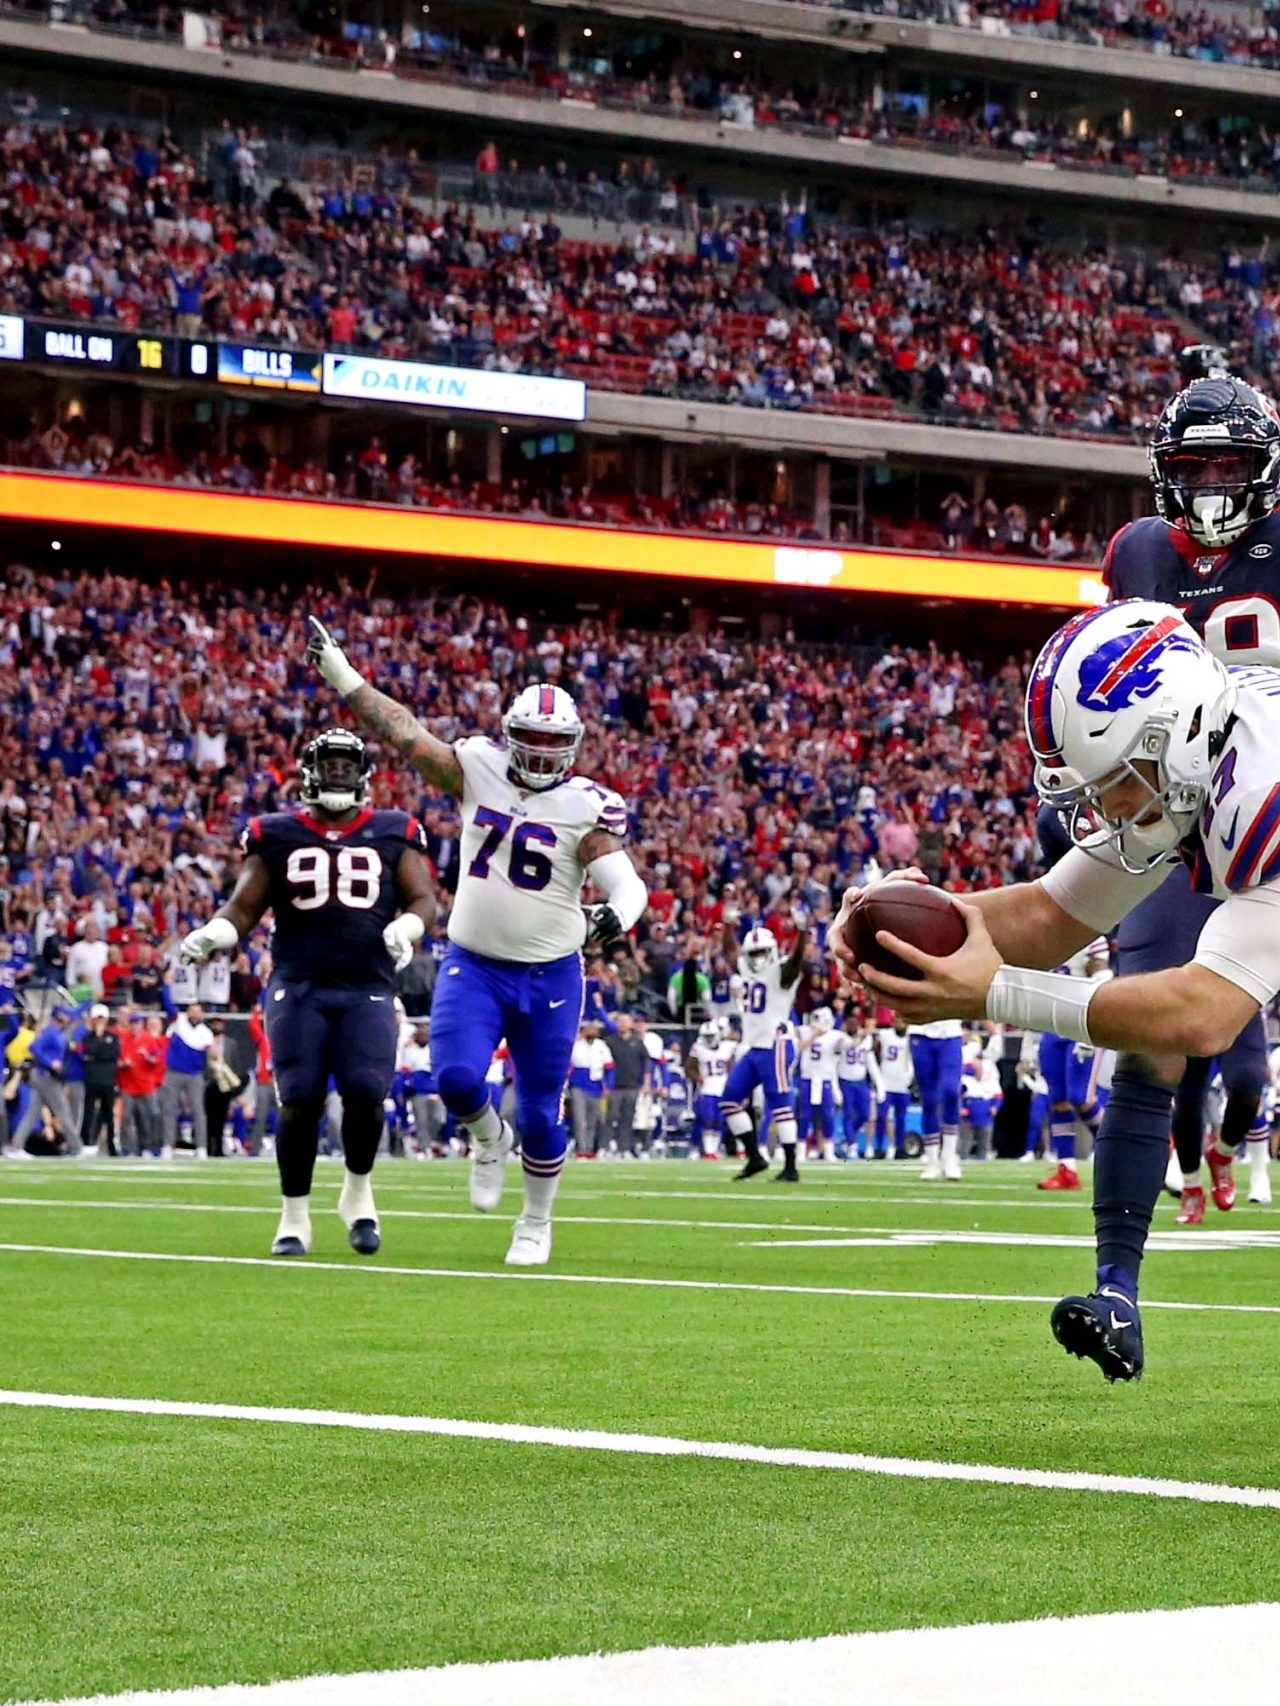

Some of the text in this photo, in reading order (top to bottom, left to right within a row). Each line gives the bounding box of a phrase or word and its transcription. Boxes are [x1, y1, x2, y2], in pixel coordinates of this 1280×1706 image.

[242, 349, 292, 378] BILLS
[361, 370, 467, 397] DAIKIN
[1179, 586, 1224, 598] TEXANS
[469, 804, 557, 892] 76
[286, 845, 383, 911] 98
